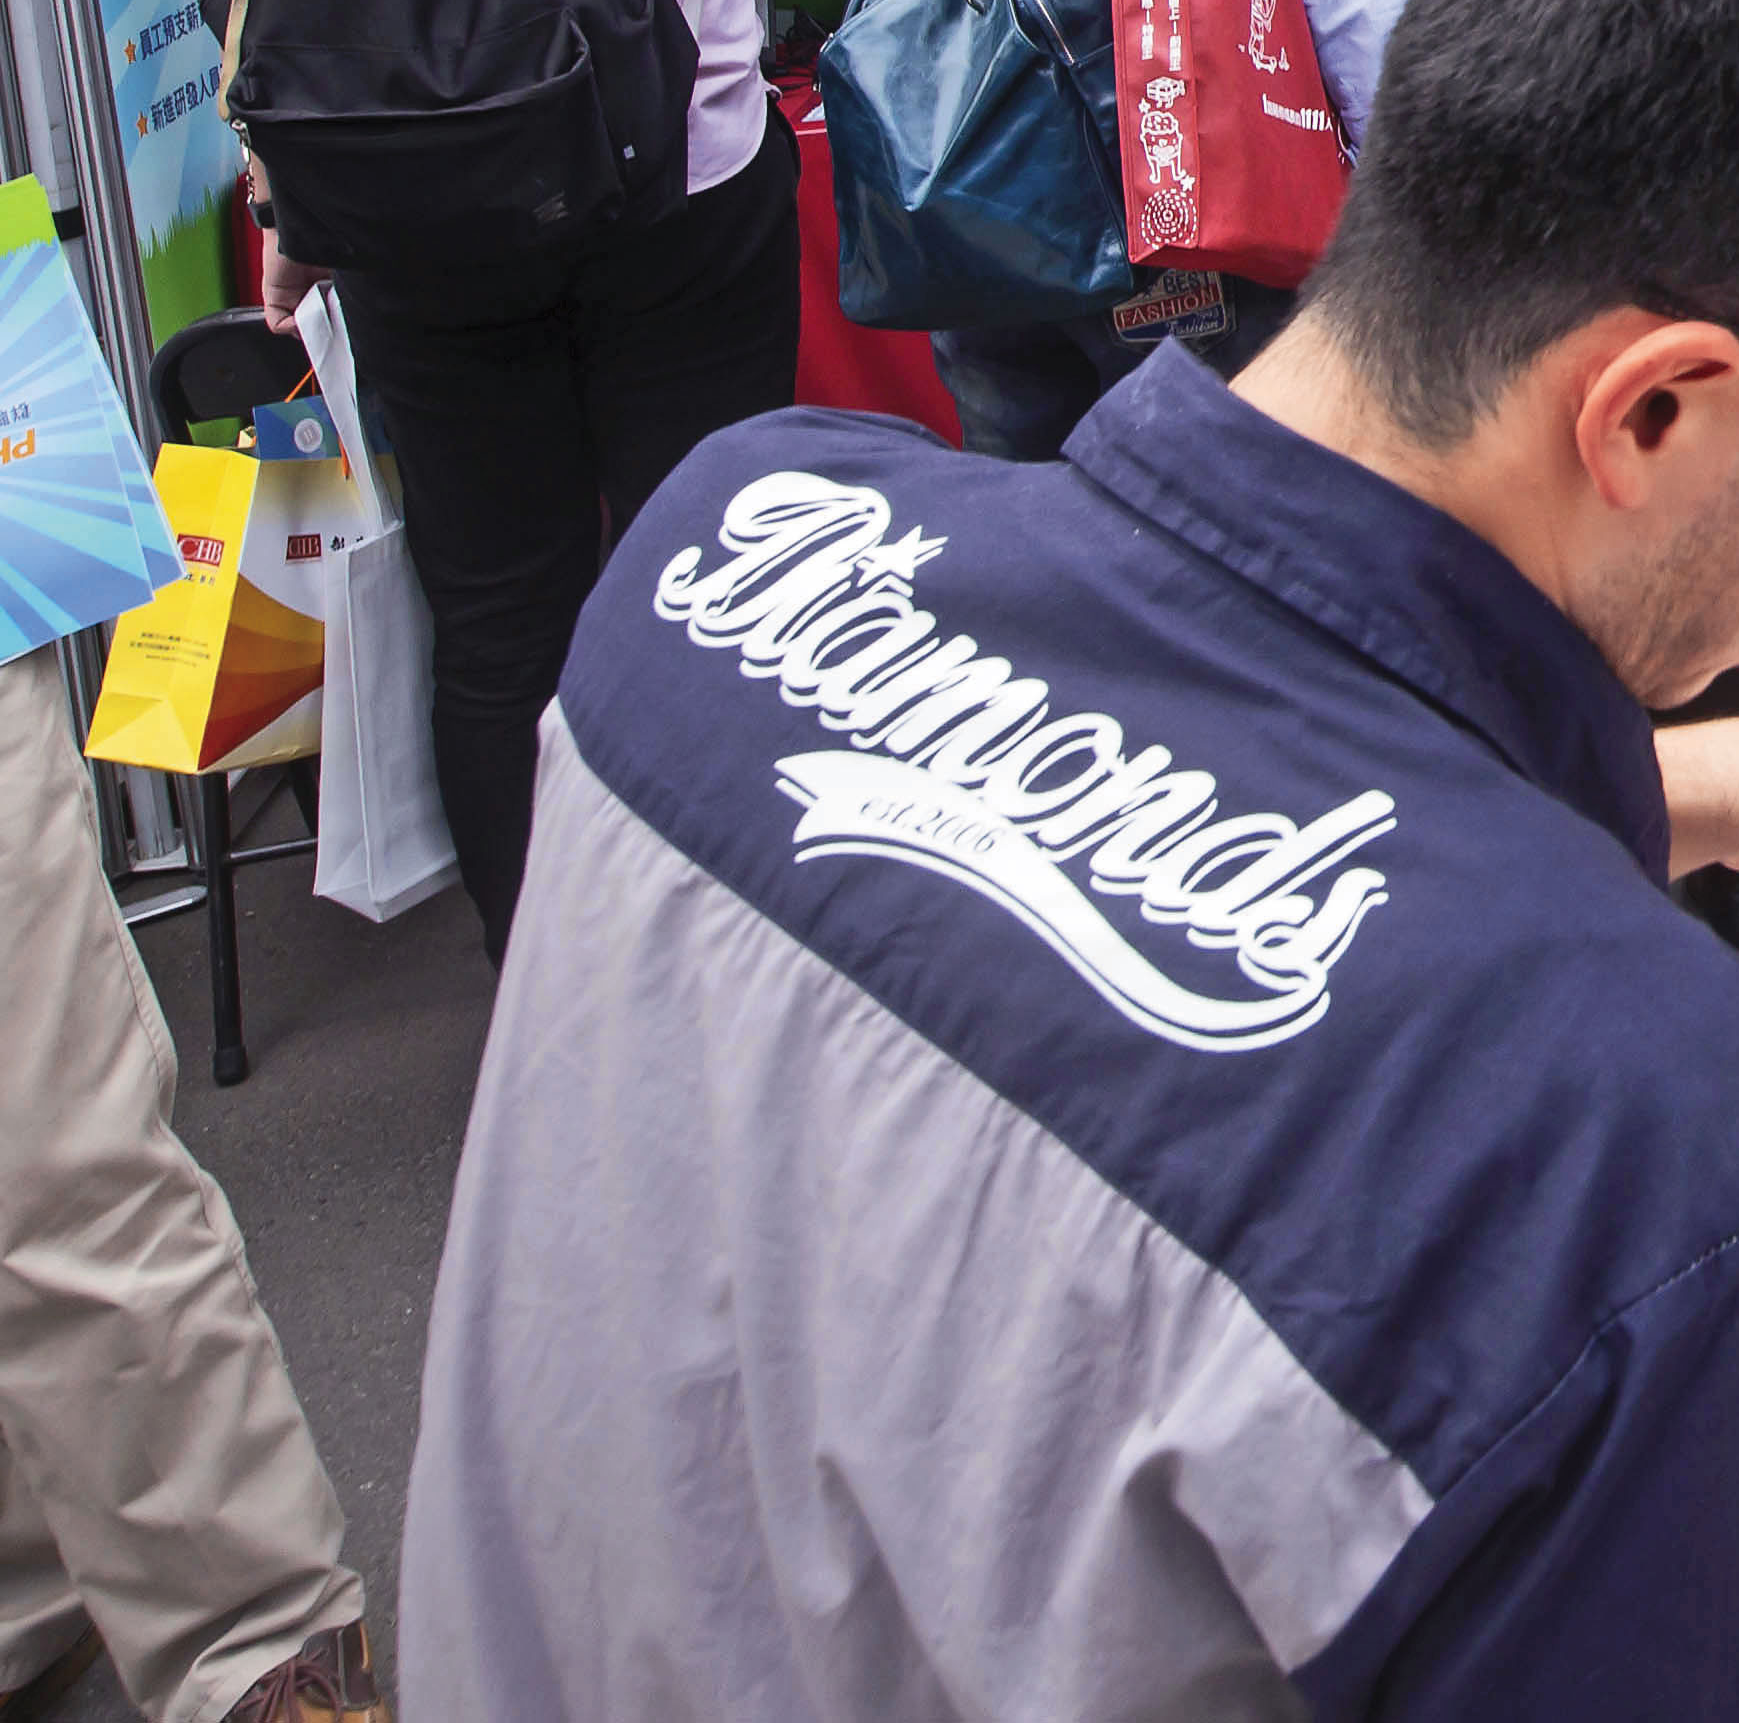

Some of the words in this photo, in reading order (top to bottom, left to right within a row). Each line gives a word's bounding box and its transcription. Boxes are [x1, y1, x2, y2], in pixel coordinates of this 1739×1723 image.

[151, 62, 222, 132] 新進研發人員
[1116, 286, 1221, 328] FASHION
